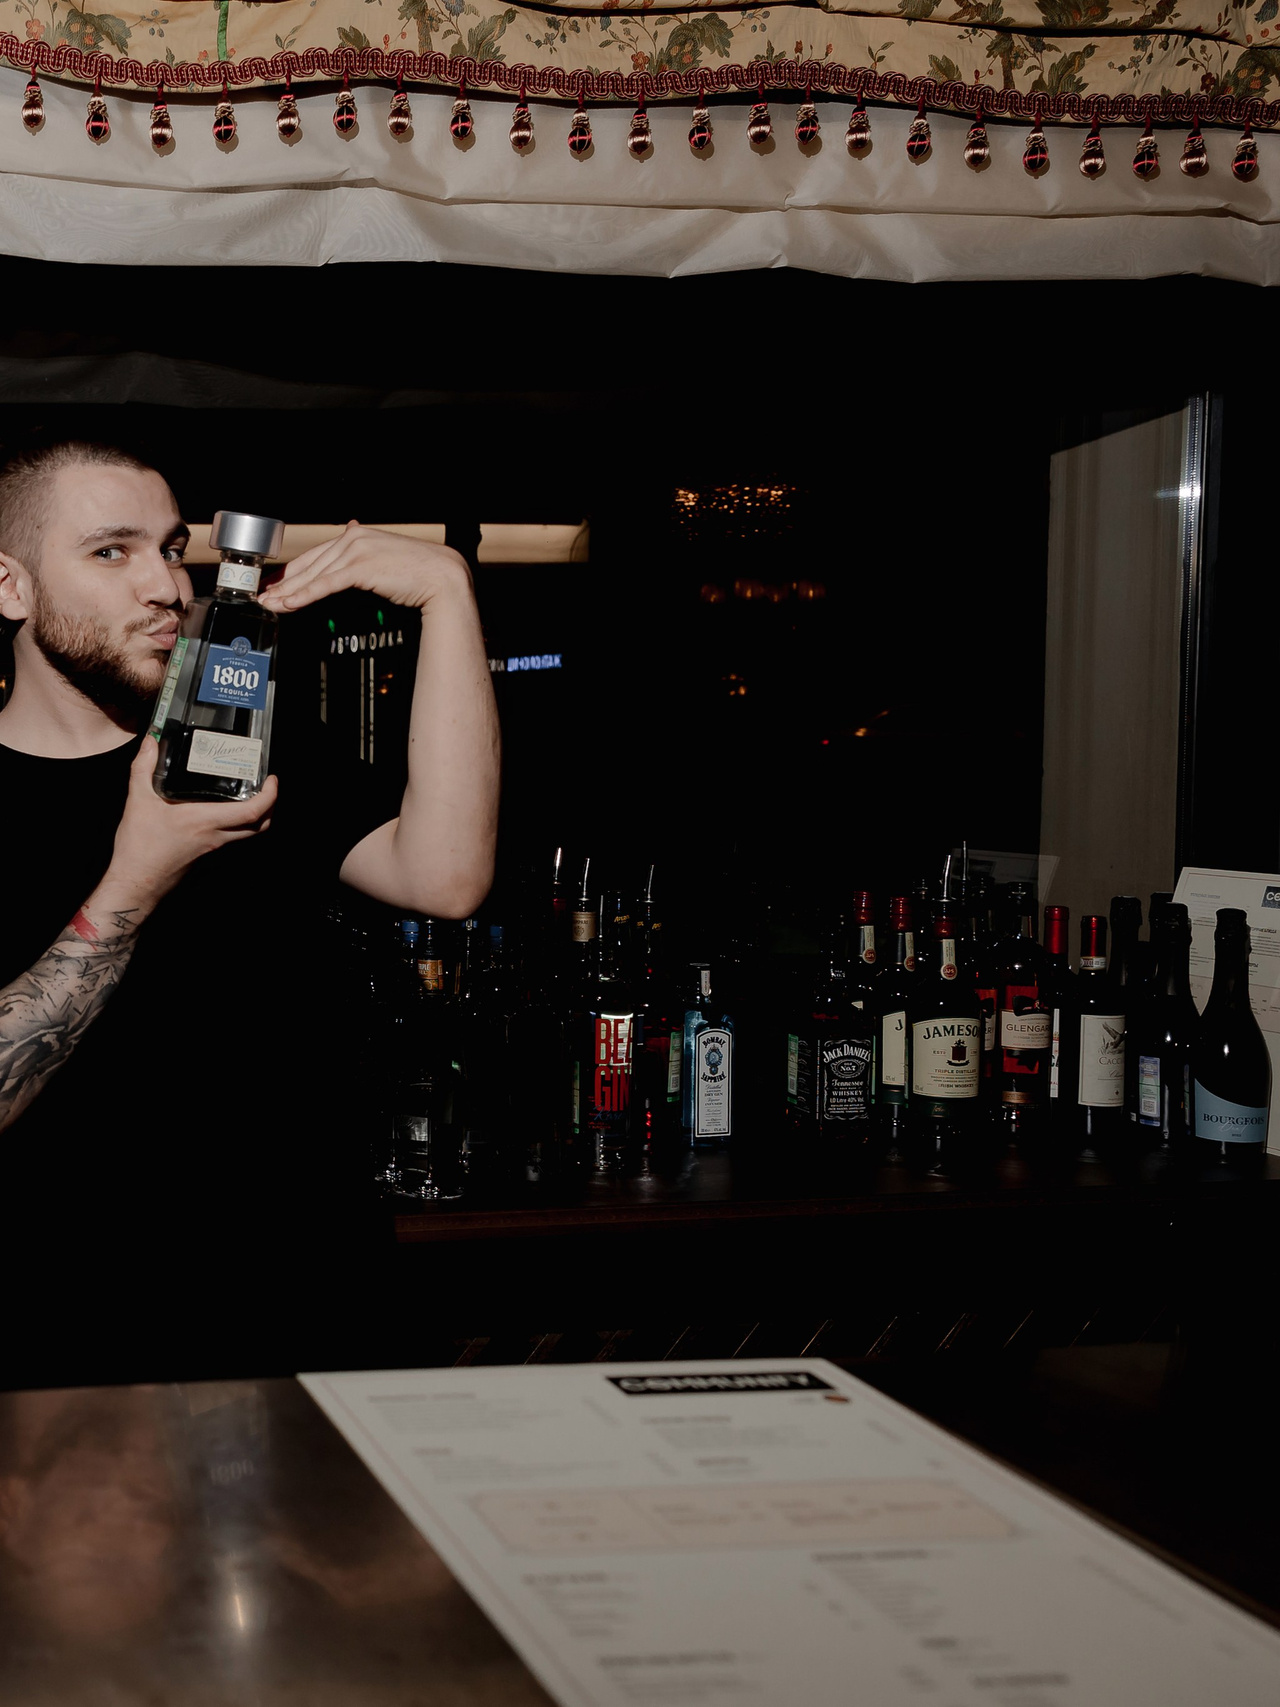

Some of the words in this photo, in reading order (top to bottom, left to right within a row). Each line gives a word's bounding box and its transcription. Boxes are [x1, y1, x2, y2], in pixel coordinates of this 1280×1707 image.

[212, 664, 260, 690] 1800
[219, 687, 250, 698] TEQUILA
[204, 740, 248, 758] Blanco
[702, 1036, 726, 1049] BOMBAY
[823, 1046, 844, 1063] JACK
[701, 1070, 727, 1083] SAPPHIRE
[831, 1078, 864, 1087] Tennessee
[594, 1065, 631, 1112] GIN
[1203, 1113, 1265, 1126] BOURGEOIS
